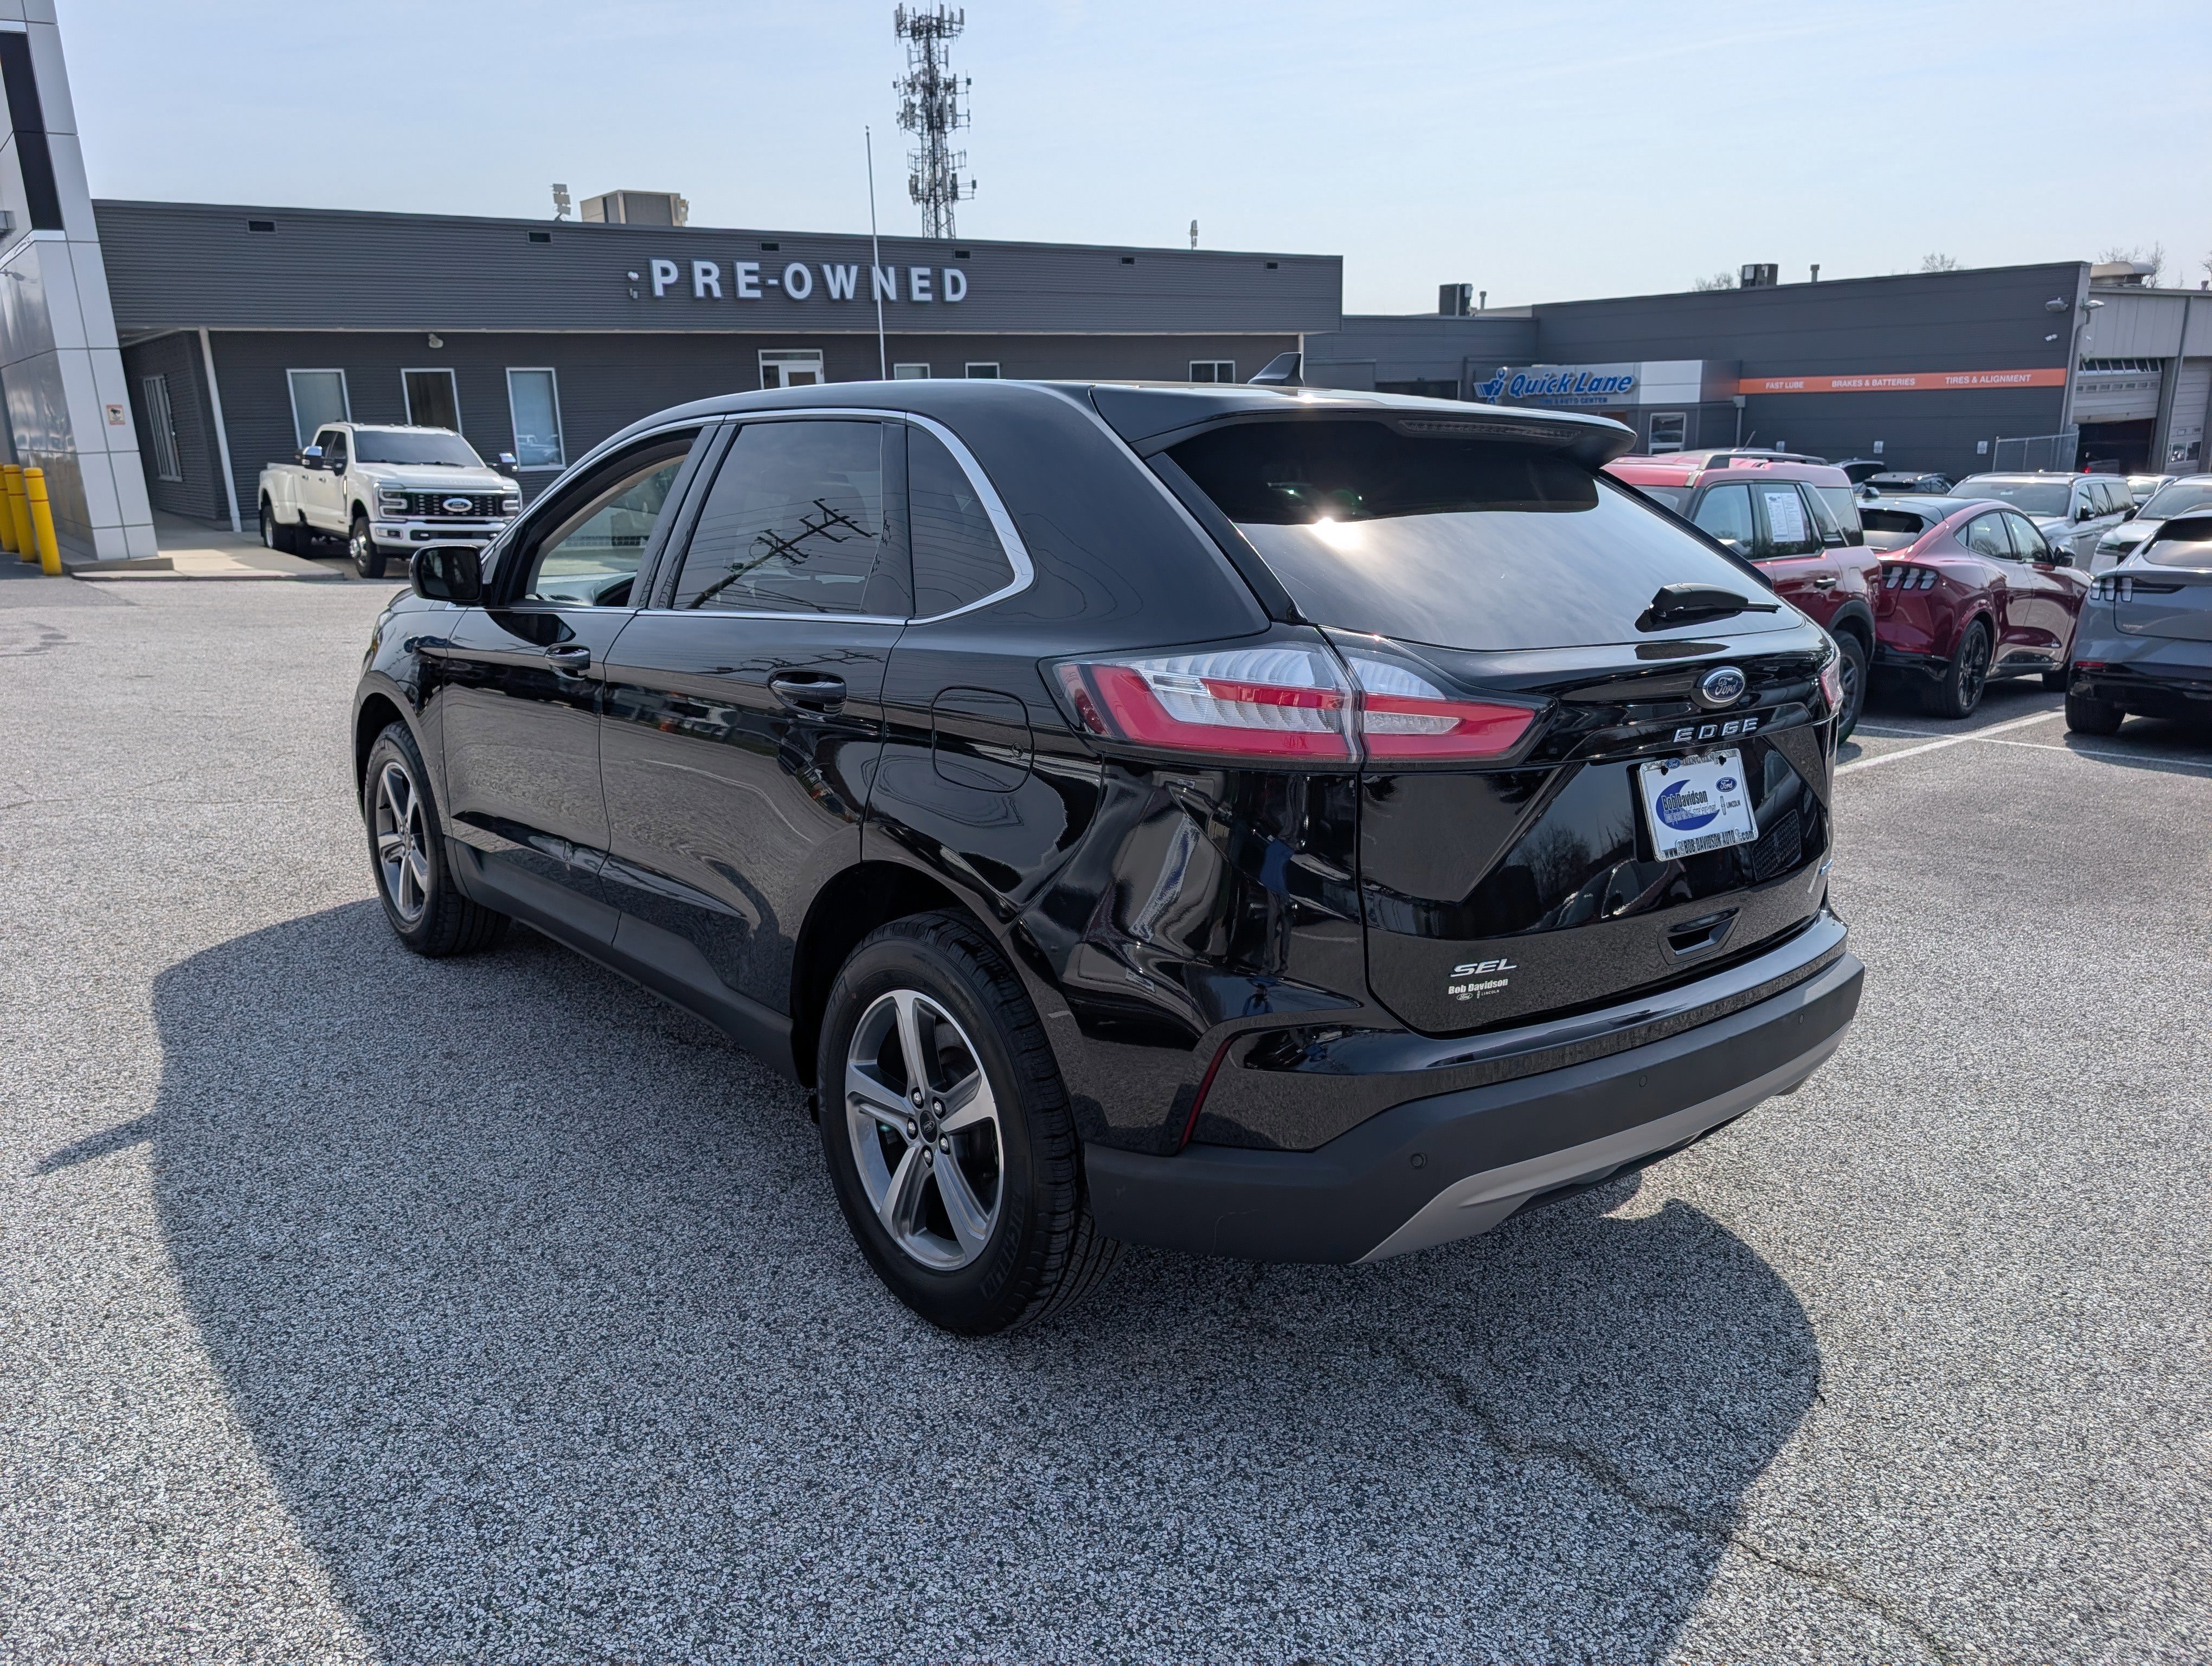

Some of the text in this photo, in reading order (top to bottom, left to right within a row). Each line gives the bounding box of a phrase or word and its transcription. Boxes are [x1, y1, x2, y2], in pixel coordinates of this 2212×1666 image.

[650, 259, 968, 302] PRE-OWNED
[1509, 371, 1633, 398] Quick Lane
[1872, 378, 1916, 387] BATTERIES
[1945, 374, 2031, 385] TIRES & ALIGNMENT
[1714, 677, 1739, 696] Ford
[1673, 717, 1759, 743] EDGE
[1662, 790, 1708, 811] Bob Davidson
[1726, 799, 1741, 809] LINCOLN
[1450, 958, 1517, 977] SEL
[1448, 978, 1508, 995] Bob Davidson
